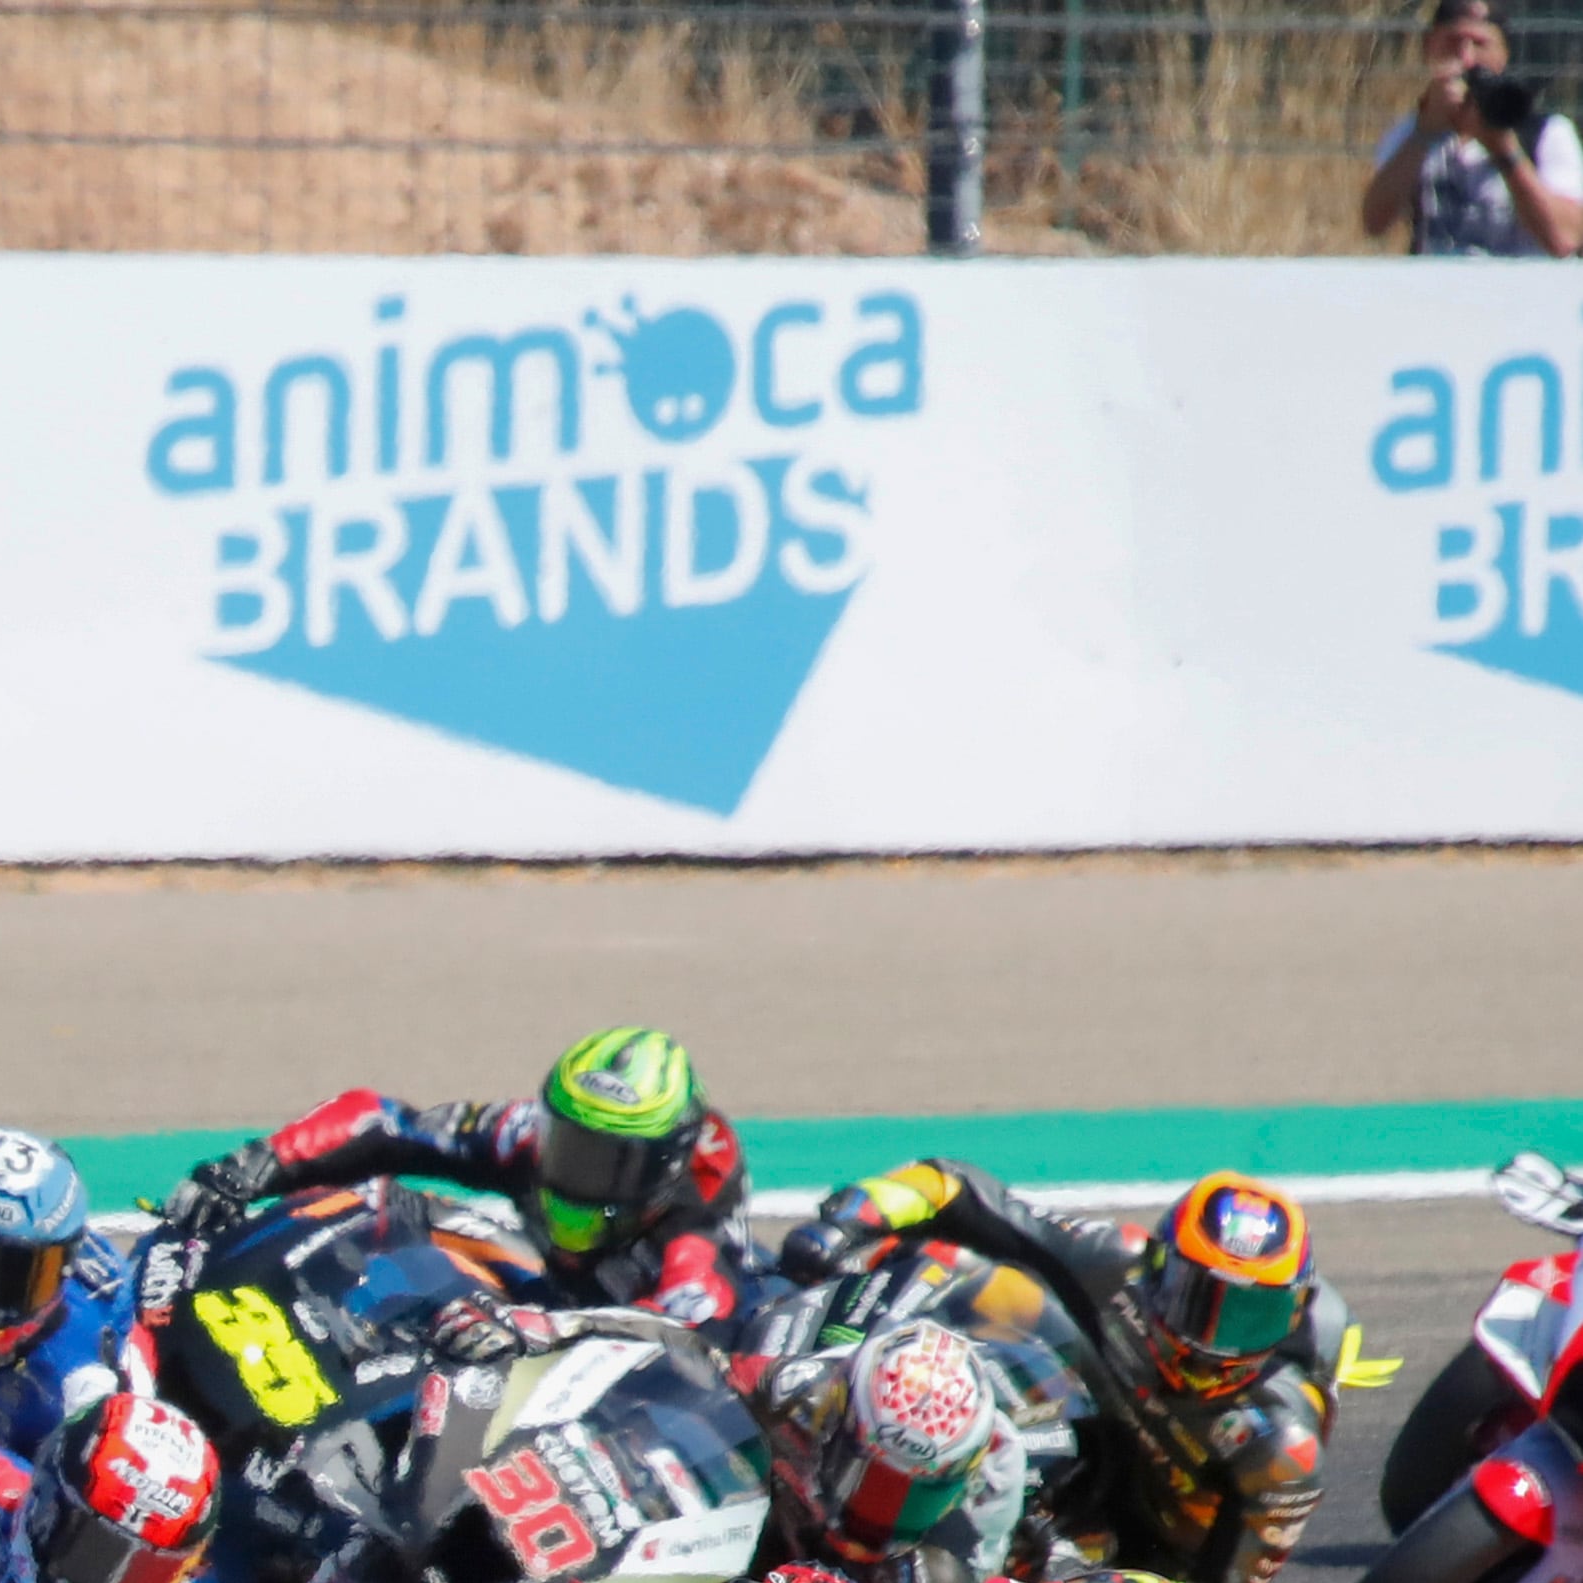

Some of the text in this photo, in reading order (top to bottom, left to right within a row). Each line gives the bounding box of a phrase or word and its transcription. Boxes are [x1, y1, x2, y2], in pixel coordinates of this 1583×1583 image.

[145, 291, 923, 496] animoca
[1369, 350, 1583, 493] an
[196, 454, 872, 655] BRANDS
[462, 1449, 598, 1583] 30
